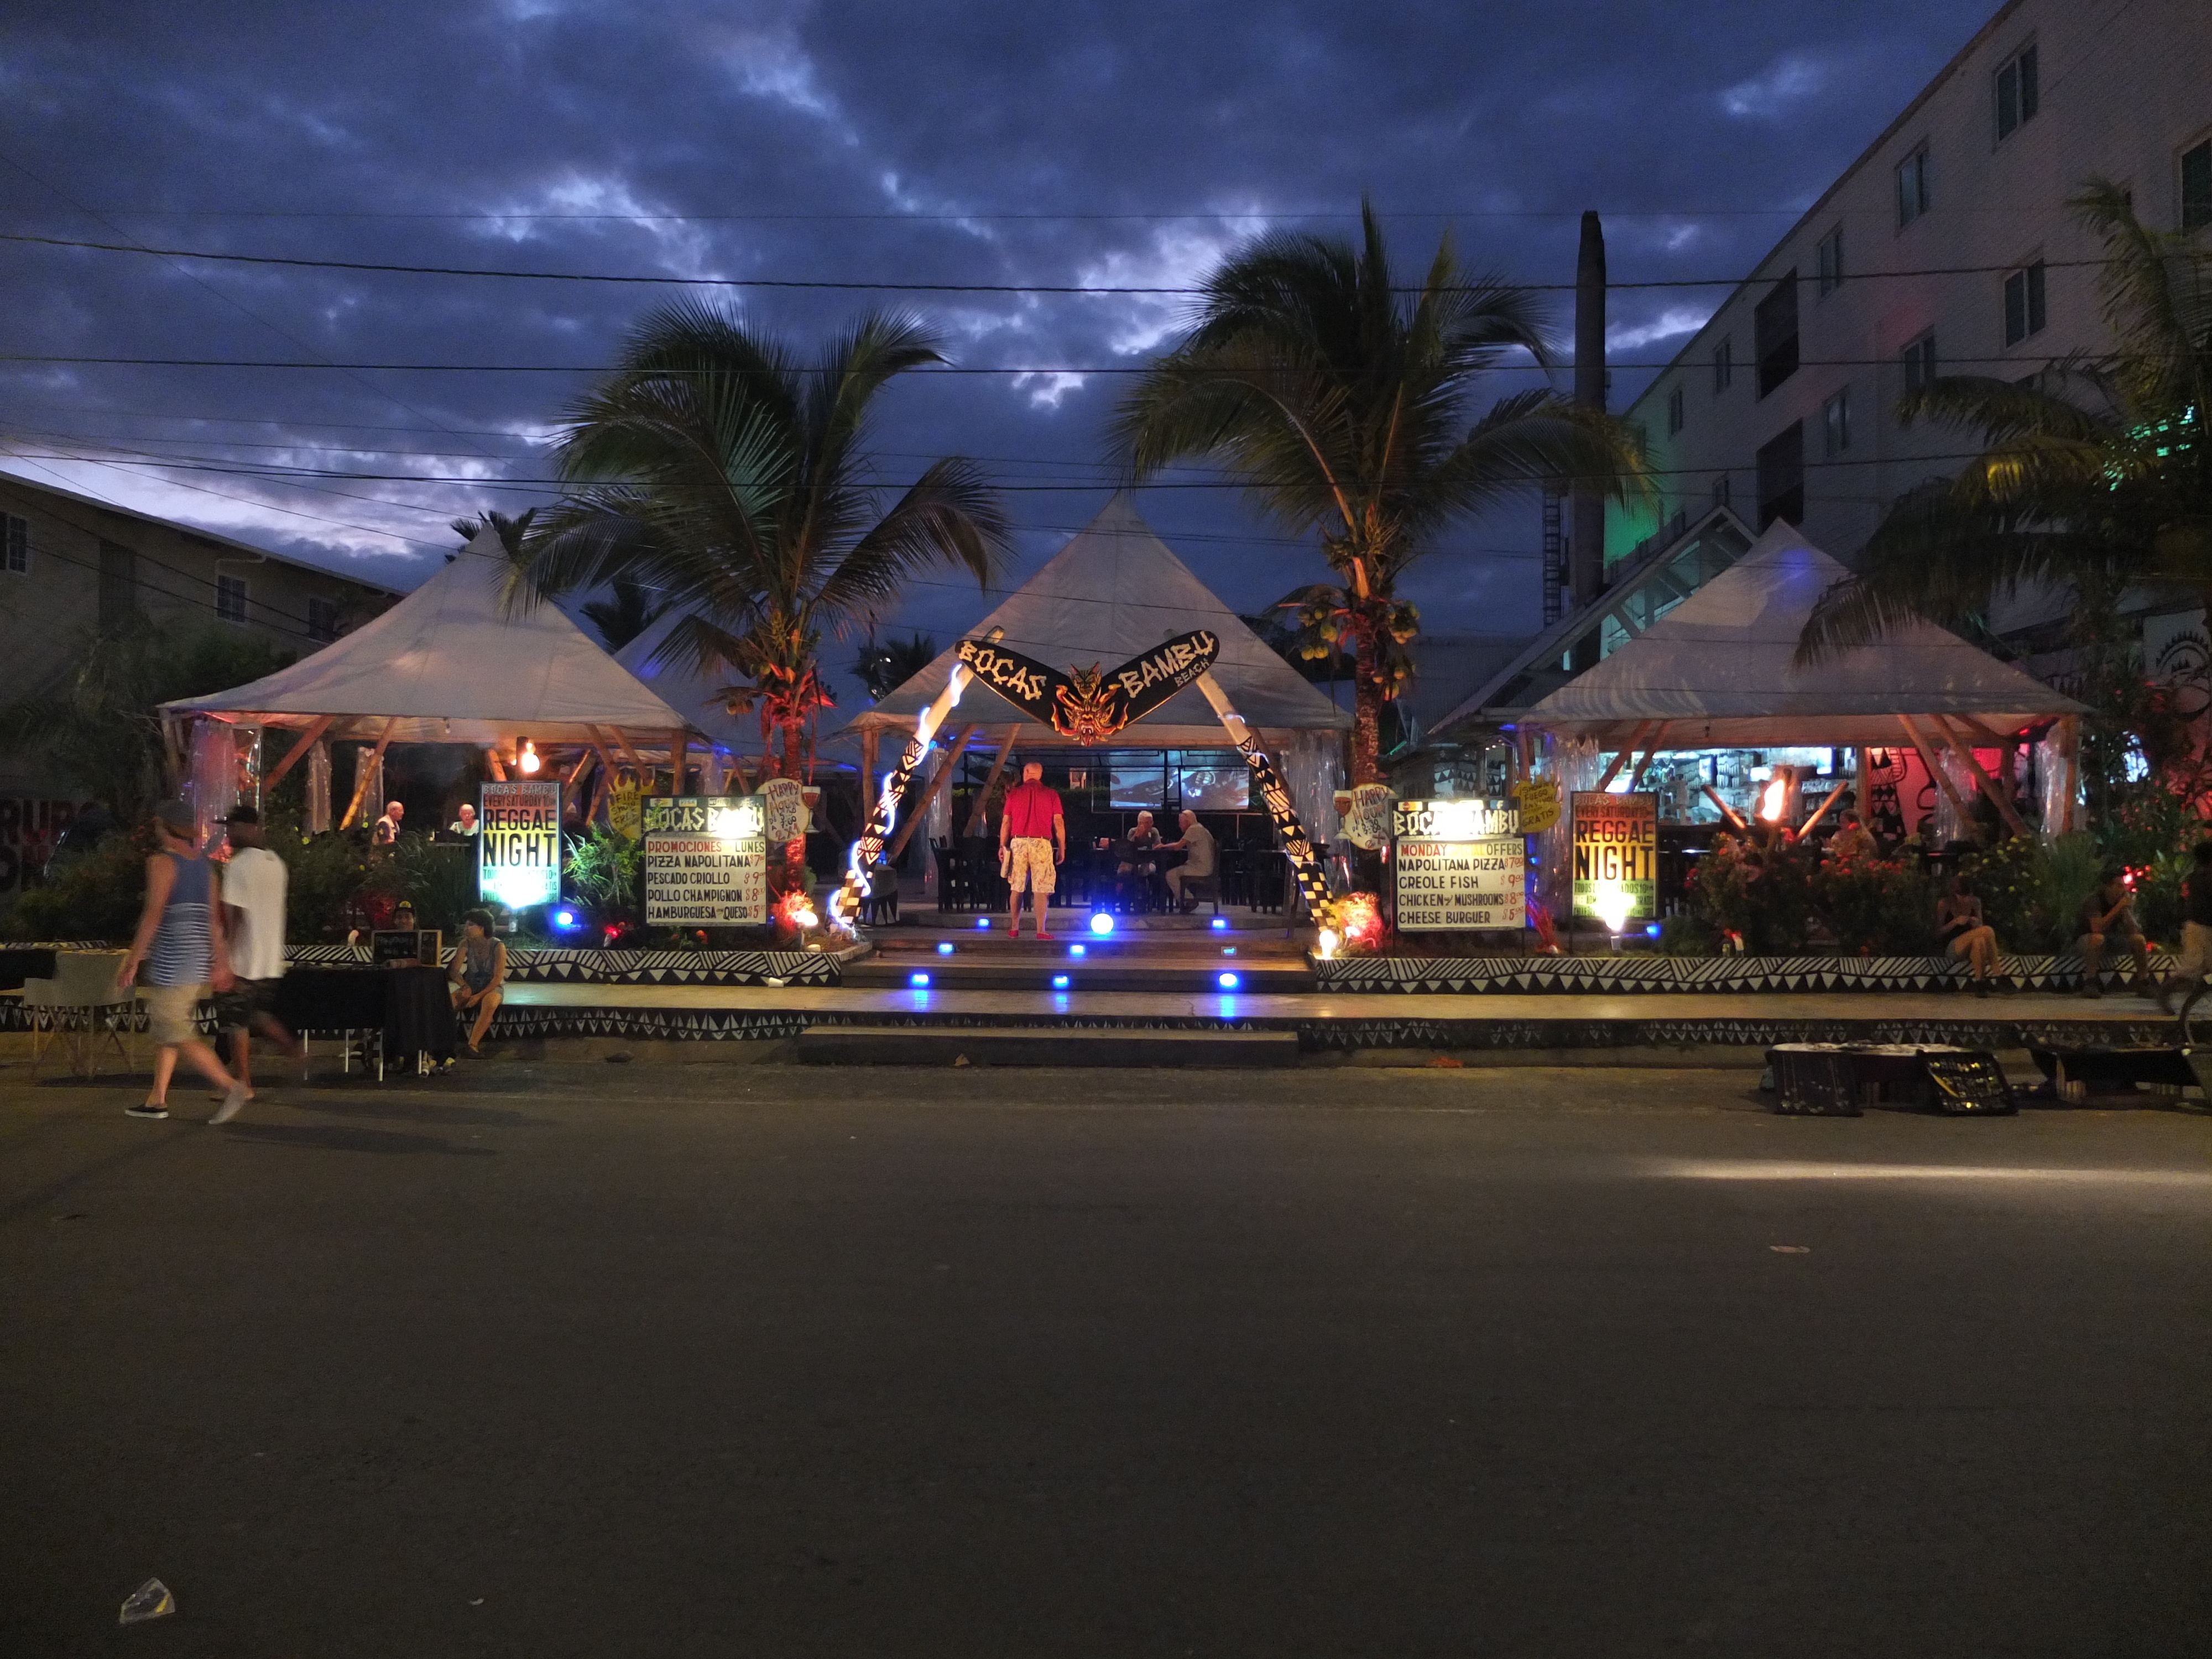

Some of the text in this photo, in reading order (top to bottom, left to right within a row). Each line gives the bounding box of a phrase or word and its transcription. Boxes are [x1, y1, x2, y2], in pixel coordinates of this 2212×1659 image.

[959, 630, 1214, 700] BOCAS BAMBU
[1174, 658, 1210, 687] BEACH
[484, 784, 517, 794] BOCAS
[768, 782, 800, 801] HAPPY
[1524, 789, 1547, 800] FUEGO
[507, 795, 542, 806] SATURDAY
[615, 791, 639, 802] FIRE
[1354, 786, 1389, 806] HAPPY
[484, 809, 556, 831] REGGAE
[1523, 808, 1554, 826] GRATIS
[1576, 820, 1654, 843] REGGAE
[483, 833, 556, 867] NIGHT
[648, 841, 765, 853] PROMOCIONES LUNES
[1401, 844, 1447, 856] MONDAY
[1487, 843, 1522, 855] OFFERS
[648, 855, 681, 867] PIZZA
[685, 855, 750, 867] NAPOLITANA
[1399, 859, 1470, 871] NAPOLITANA
[1473, 858, 1505, 870] PIZZA
[1575, 846, 1653, 880] NIGHT
[648, 872, 687, 884] PESCADO
[690, 872, 730, 884] CRIOLLO
[1399, 876, 1445, 889] CREOLE
[1451, 876, 1479, 888] FISH
[1574, 883, 1592, 893] TODOS
[648, 889, 681, 901] POLLO
[684, 889, 742, 901] CHAMPIGNON
[1399, 894, 1444, 906] CHICKEN
[1455, 894, 1504, 906] MUSHROOMS
[648, 906, 716, 919] HAMBURGUESA
[723, 906, 747, 920] QUESO
[1399, 911, 1441, 924] CHEESE
[1446, 911, 1490, 924] BURGUER
